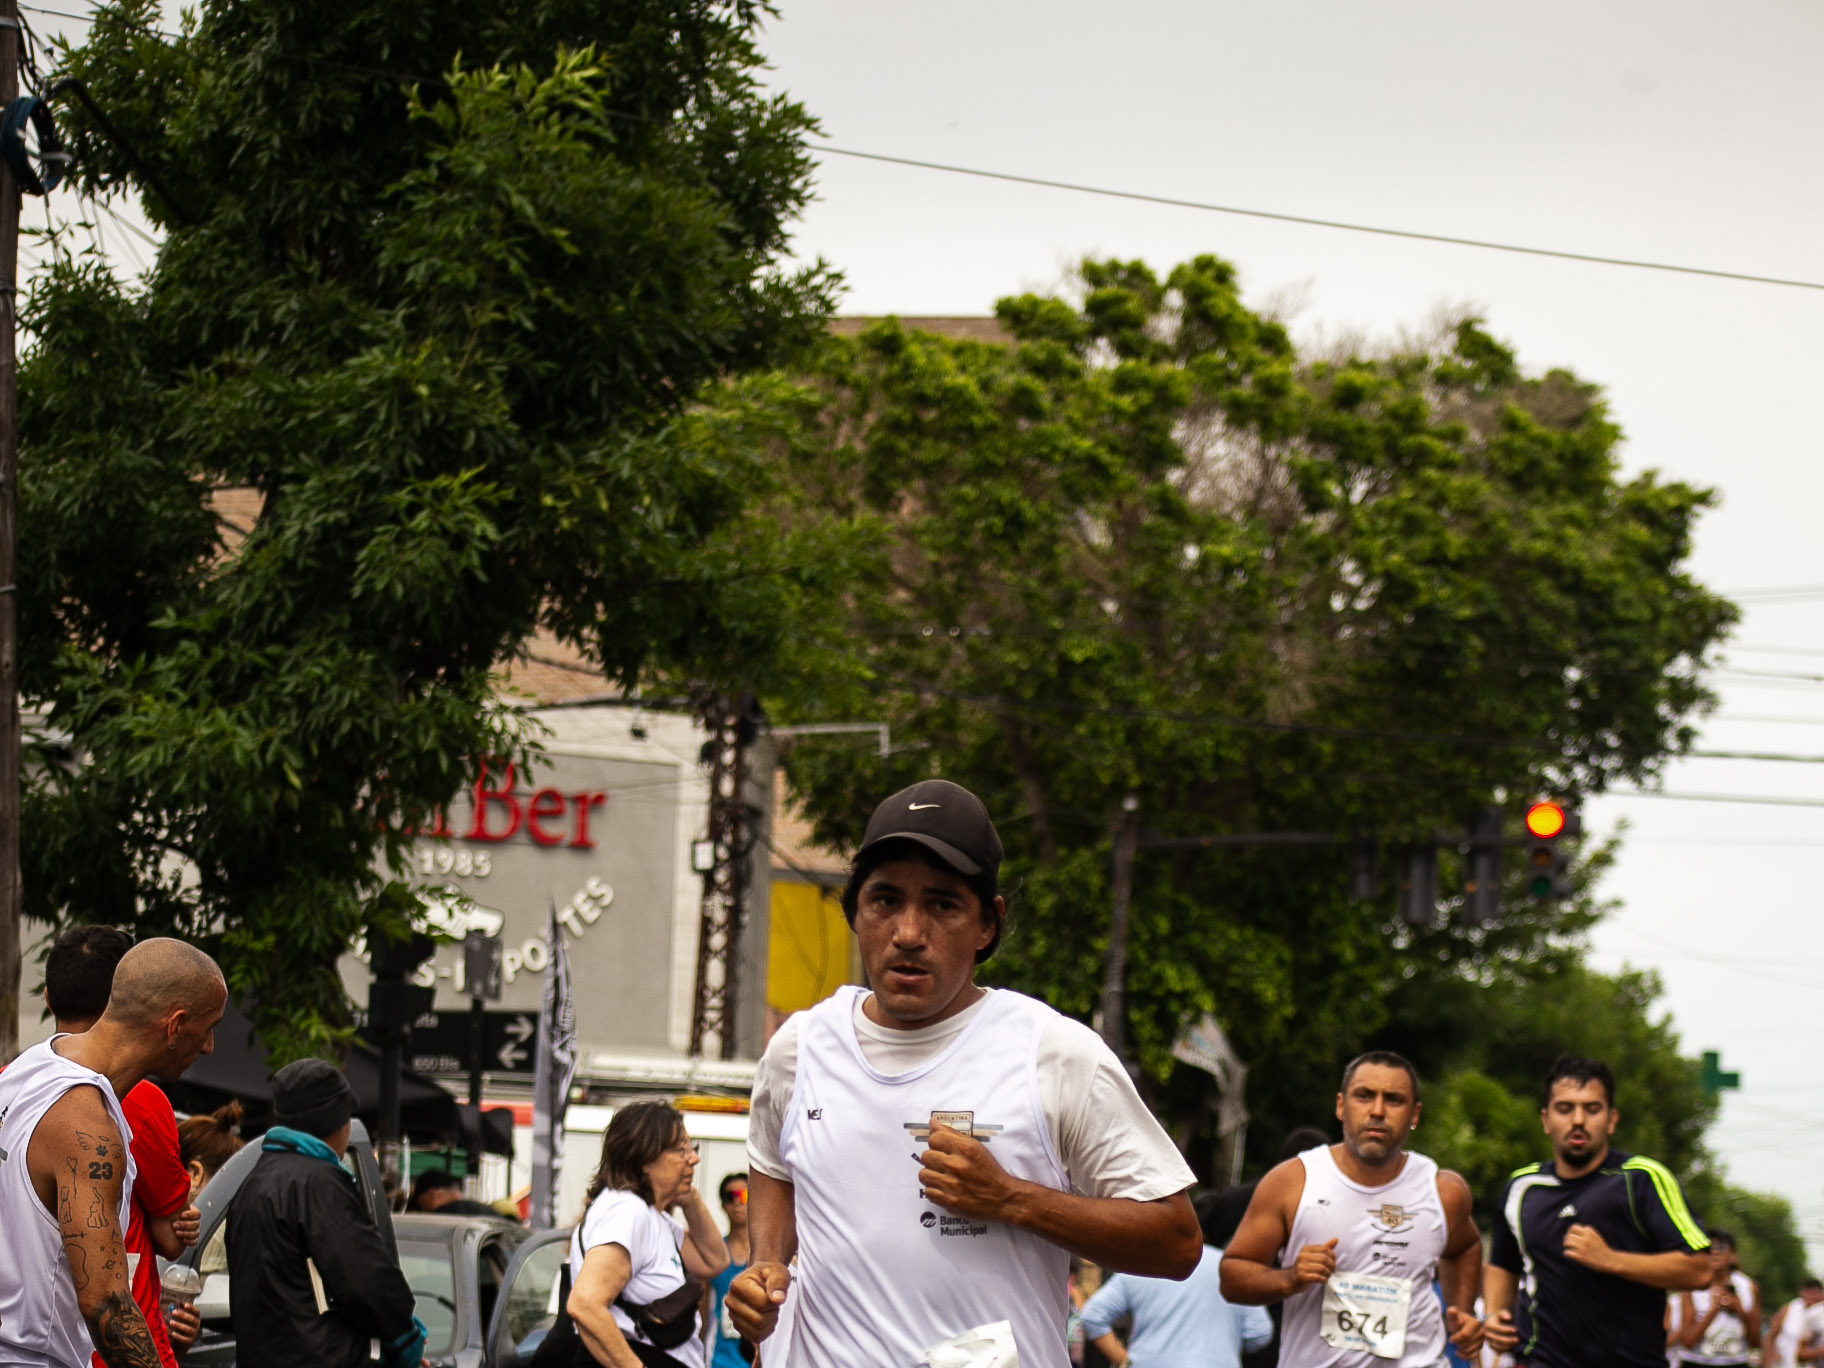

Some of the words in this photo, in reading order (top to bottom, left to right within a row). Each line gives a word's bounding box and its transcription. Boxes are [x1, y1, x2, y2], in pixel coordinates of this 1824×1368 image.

[430, 757, 607, 848] Ber
[419, 849, 492, 877] 1985
[89, 1161, 113, 1180] 23
[940, 1225, 987, 1236] Municipal
[1337, 1310, 1388, 1340] 674
